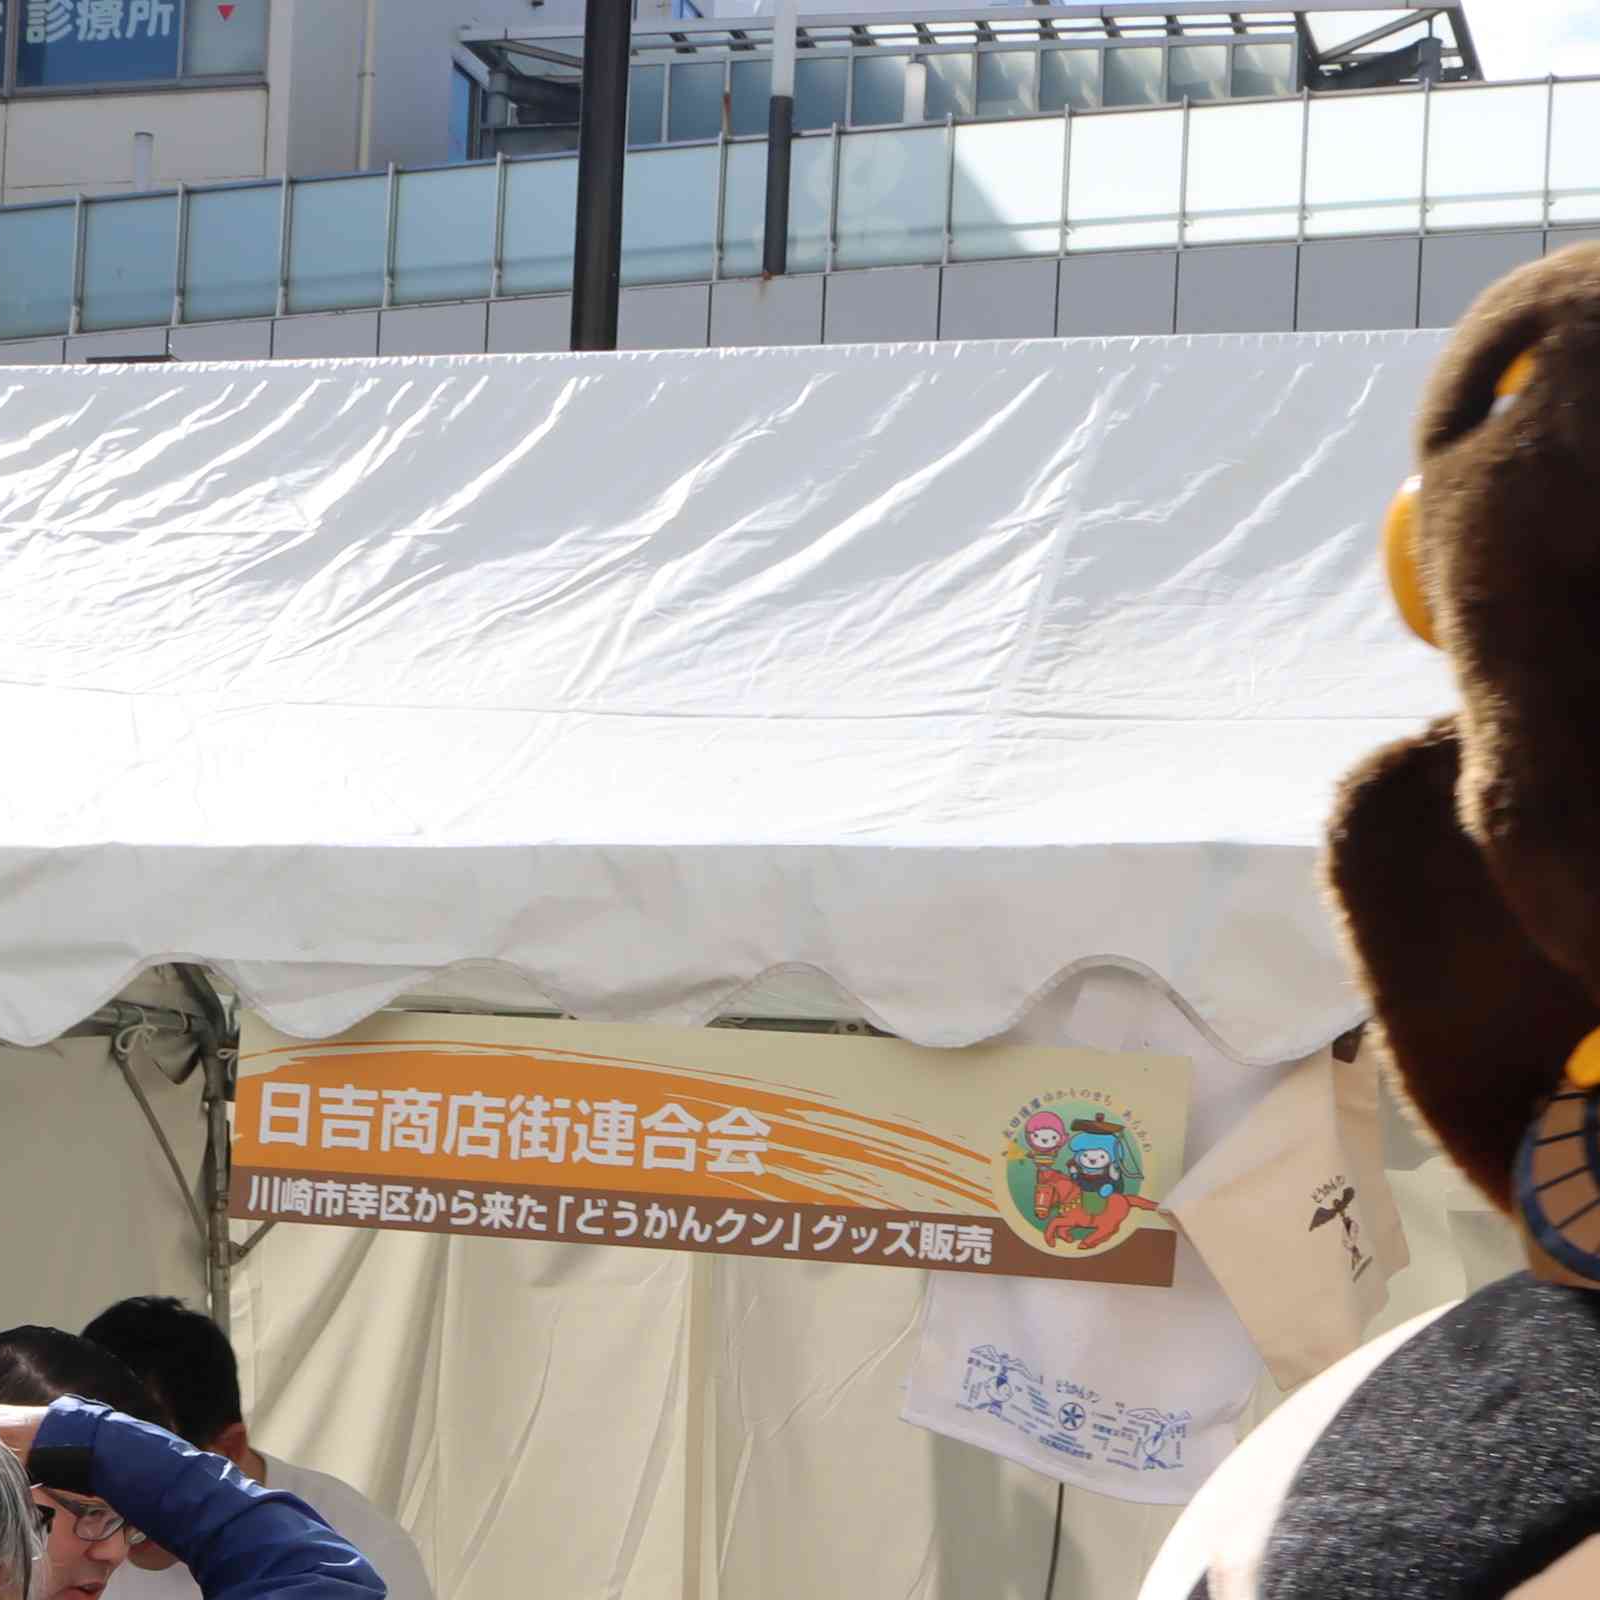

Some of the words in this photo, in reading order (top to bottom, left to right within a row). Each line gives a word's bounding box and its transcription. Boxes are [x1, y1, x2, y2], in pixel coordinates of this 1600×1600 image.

[257, 1082, 772, 1176] 日吉商店街連合会
